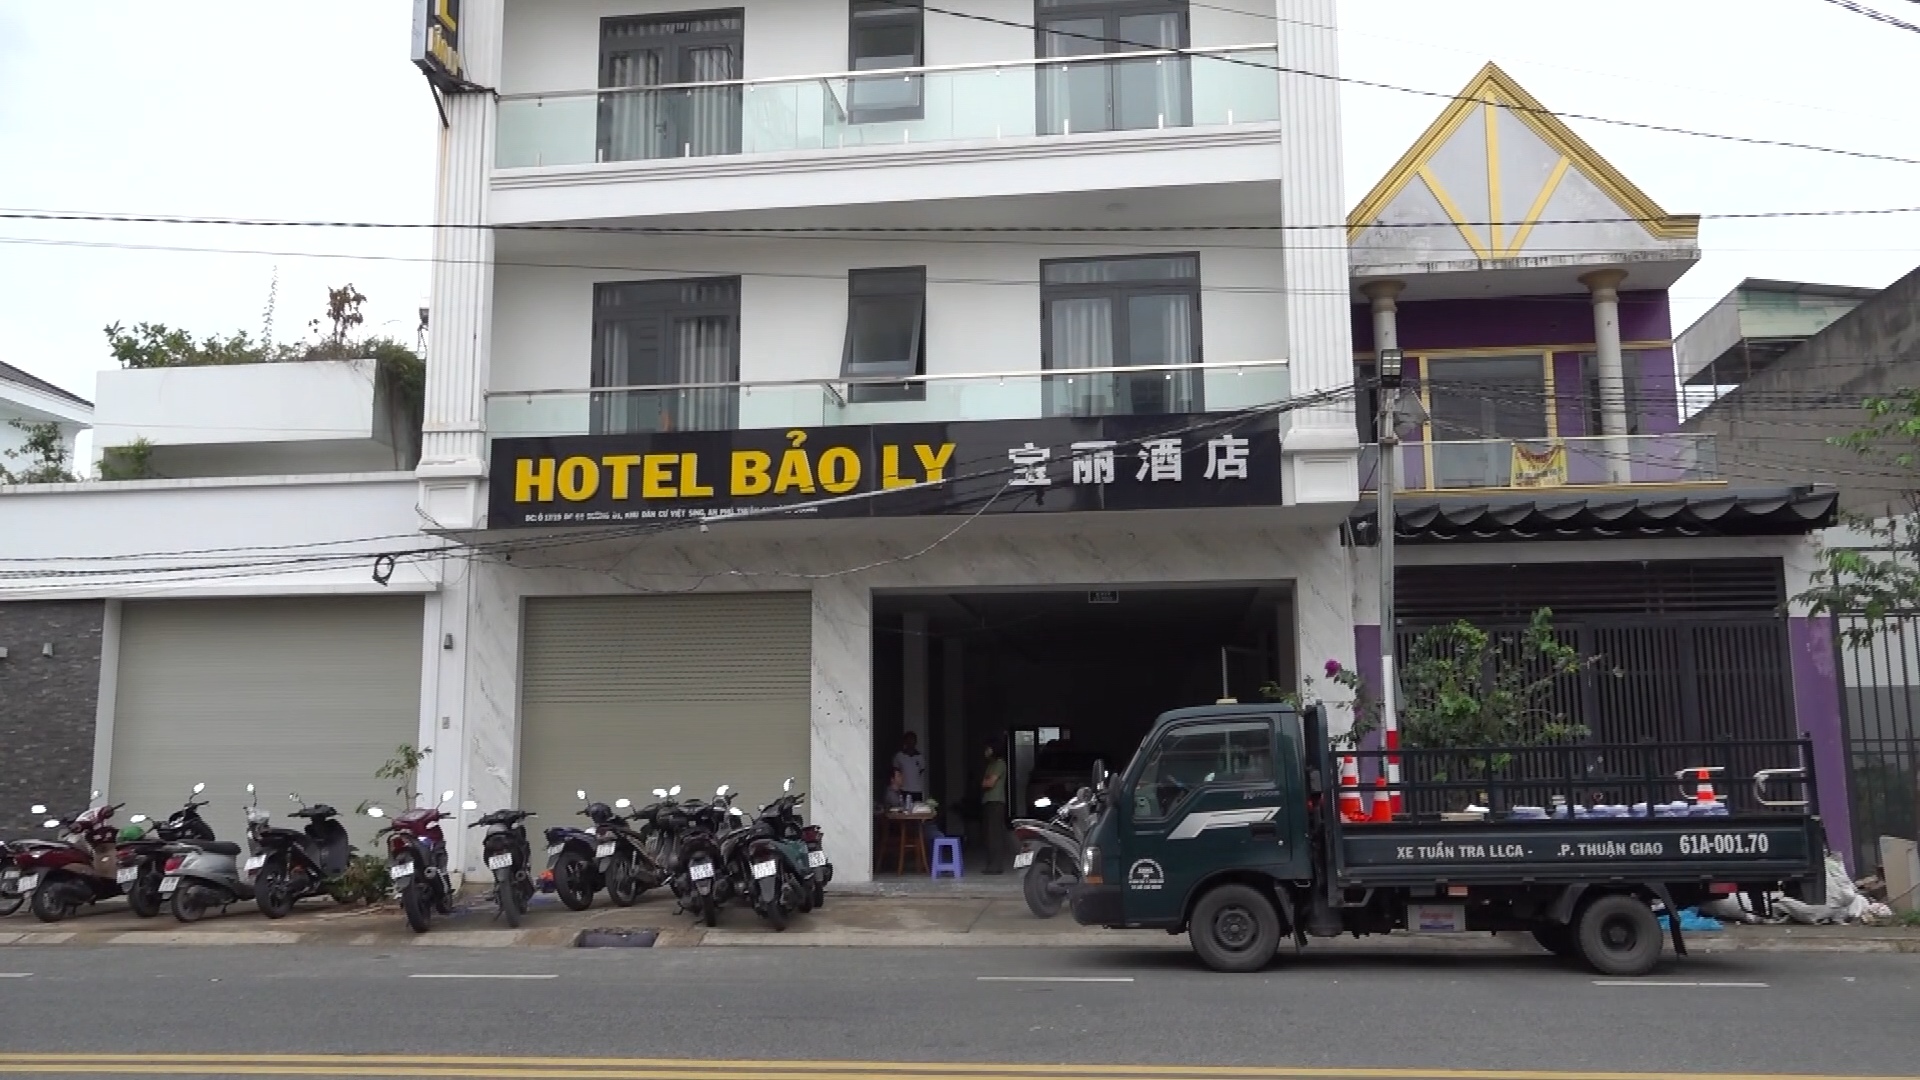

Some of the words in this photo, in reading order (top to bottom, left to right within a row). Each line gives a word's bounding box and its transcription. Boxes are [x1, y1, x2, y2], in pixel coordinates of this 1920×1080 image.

[515, 453, 714, 502] HOTEL
[731, 429, 862, 496] BẢO
[883, 442, 956, 491] LY
[1396, 846, 1414, 859] XE
[1418, 841, 1454, 858] TUẤN
[1458, 845, 1485, 858] TRA
[1489, 845, 1524, 858] LLCA
[1578, 841, 1627, 857] THUẬN
[1630, 842, 1664, 856] GIAO
[1679, 833, 1769, 854] 61A-001.70
